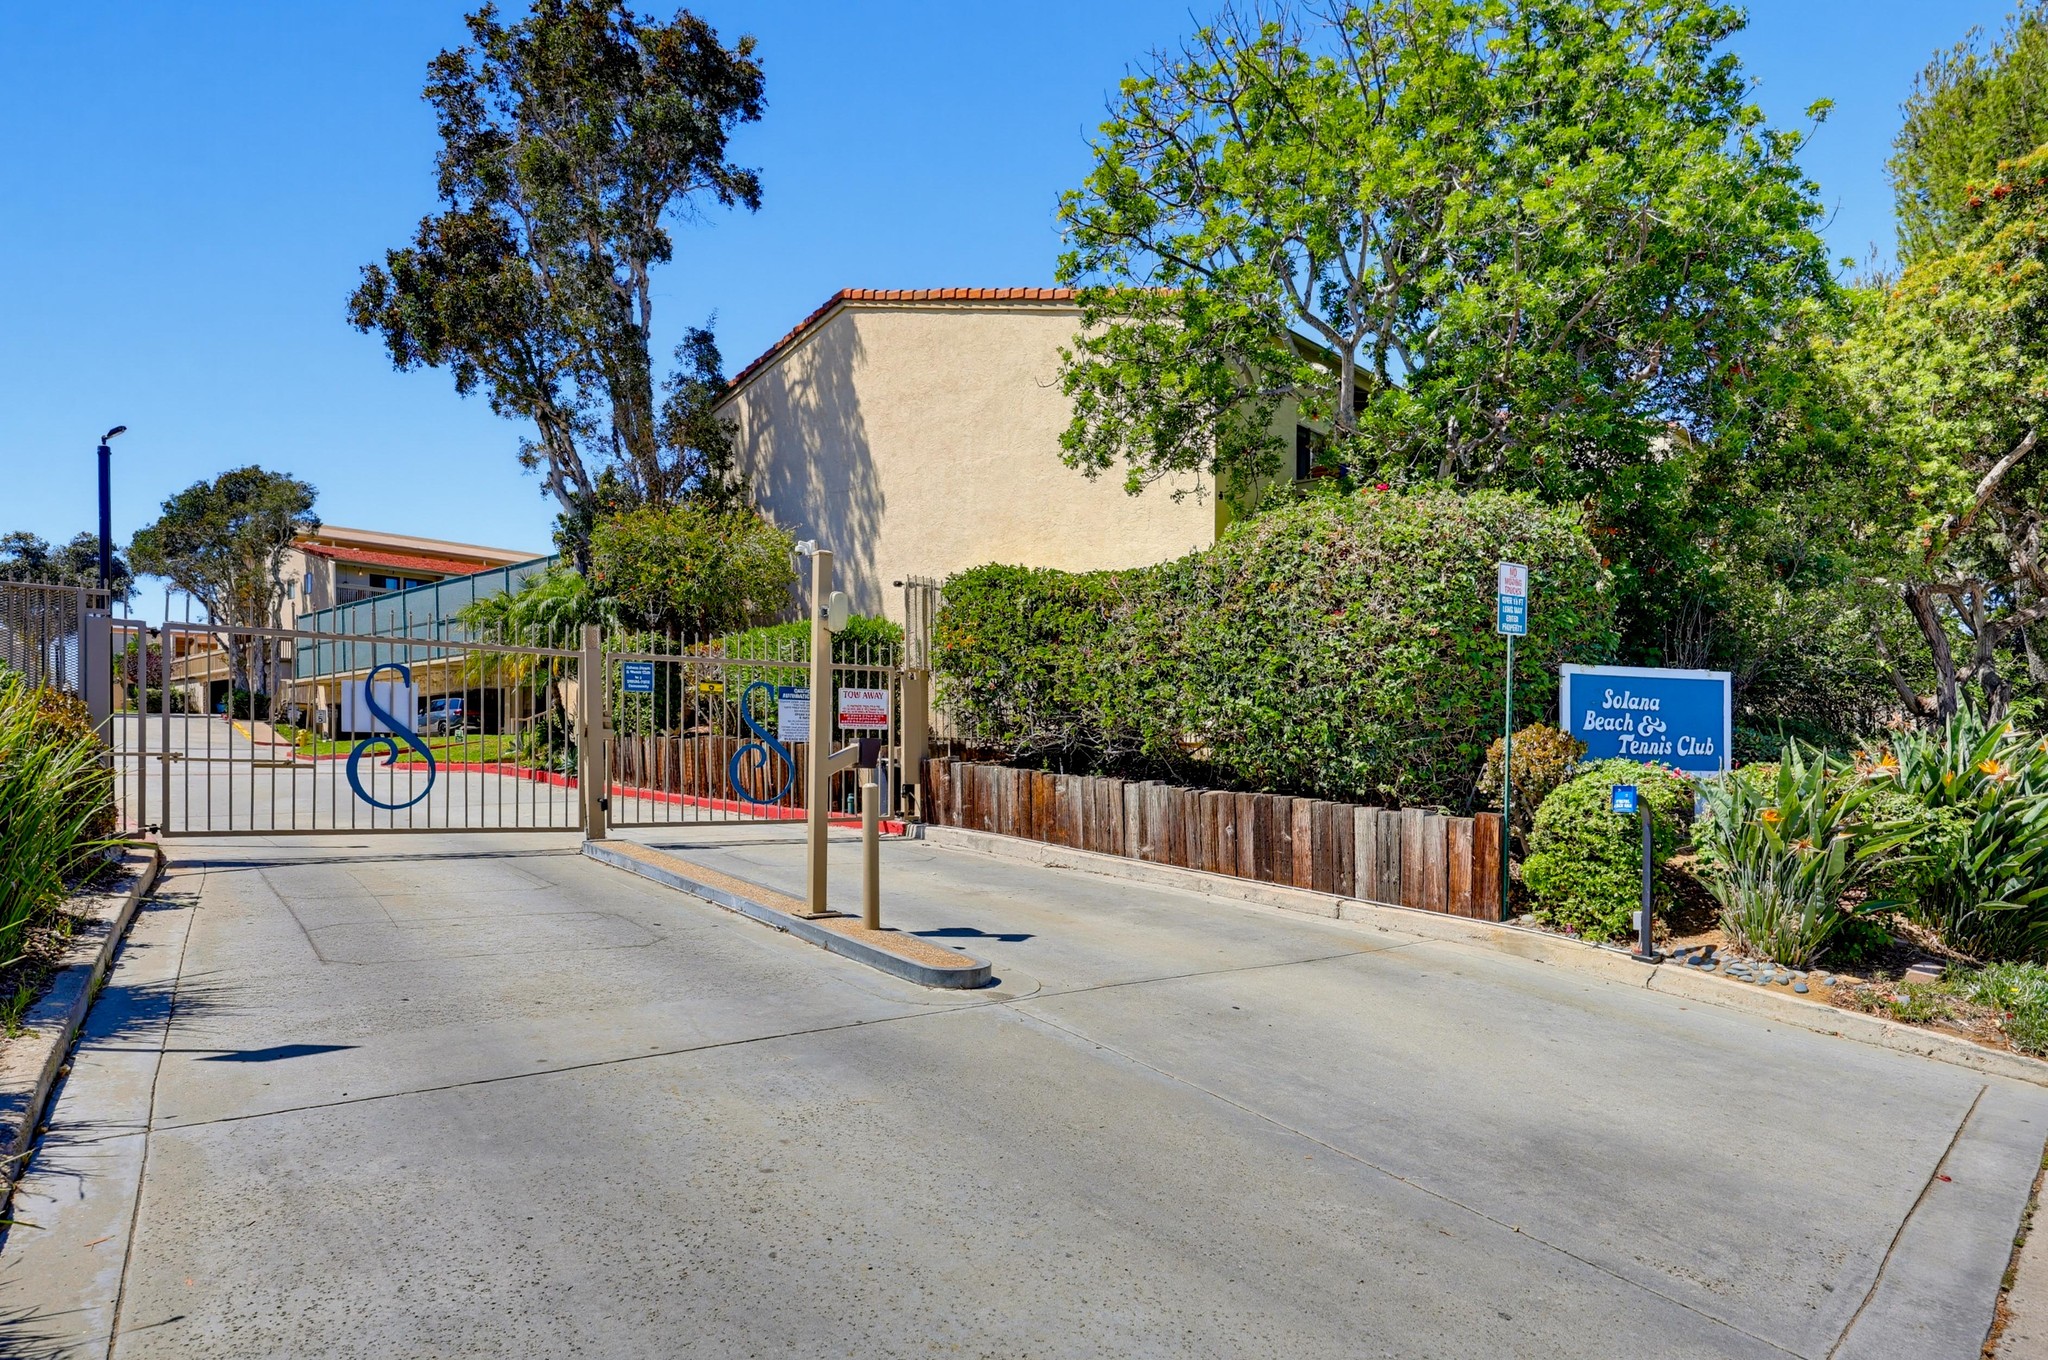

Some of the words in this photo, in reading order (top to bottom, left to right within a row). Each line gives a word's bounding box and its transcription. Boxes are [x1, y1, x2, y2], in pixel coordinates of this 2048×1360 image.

[1509, 567, 1518, 577] NO
[1504, 585, 1522, 595] TRUCKS
[1502, 623, 1523, 632] PROPERTY
[842, 690, 861, 699] TOW
[862, 691, 884, 700] AWAY
[1602, 688, 1661, 711] Solana
[1583, 710, 1634, 732] Beach
[1637, 715, 1667, 738] &
[1618, 733, 1673, 756] Tennis
[1676, 735, 1715, 757] Club
